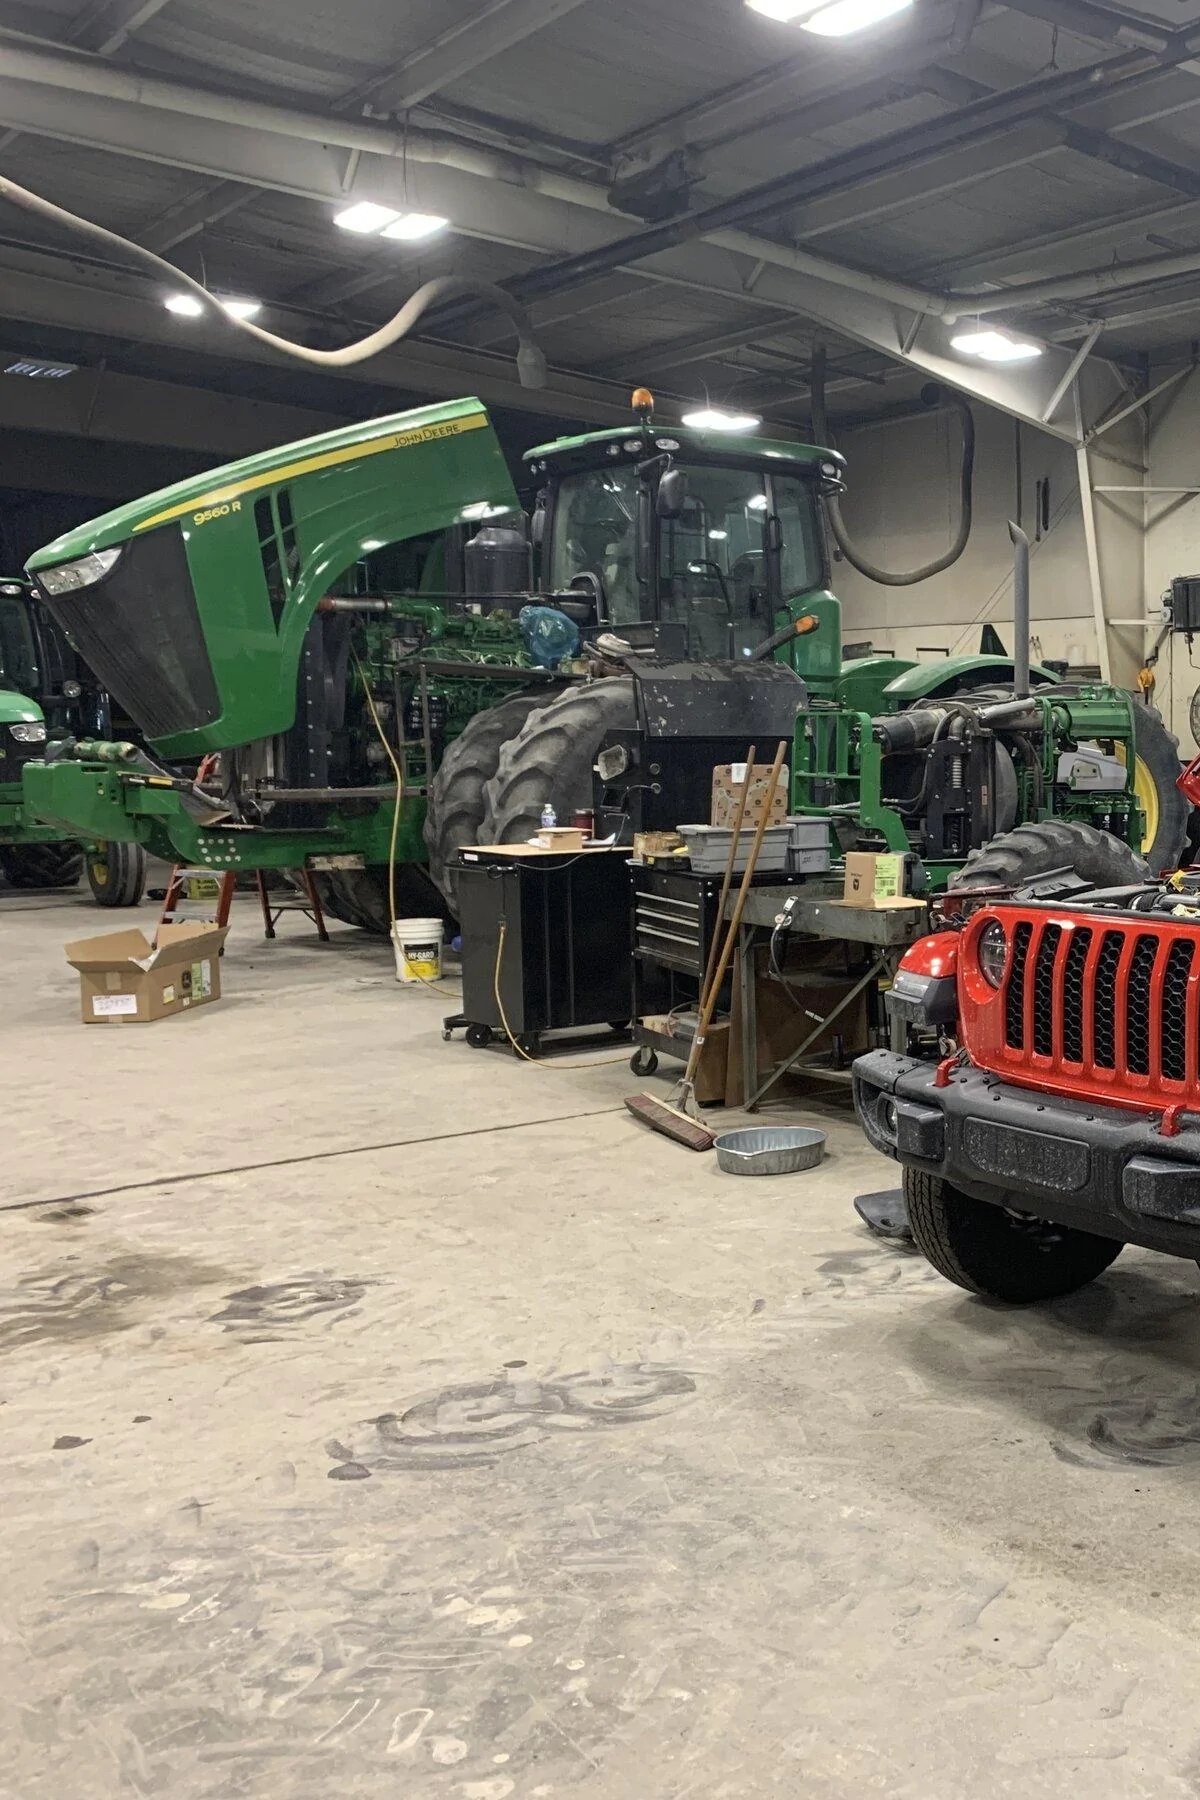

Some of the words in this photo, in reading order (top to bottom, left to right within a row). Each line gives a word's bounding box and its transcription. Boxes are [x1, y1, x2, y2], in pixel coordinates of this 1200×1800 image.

[394, 433, 422, 447] JOHN
[422, 424, 460, 439] DEERE
[193, 507, 230, 526] 9560
[231, 501, 241, 512] R
